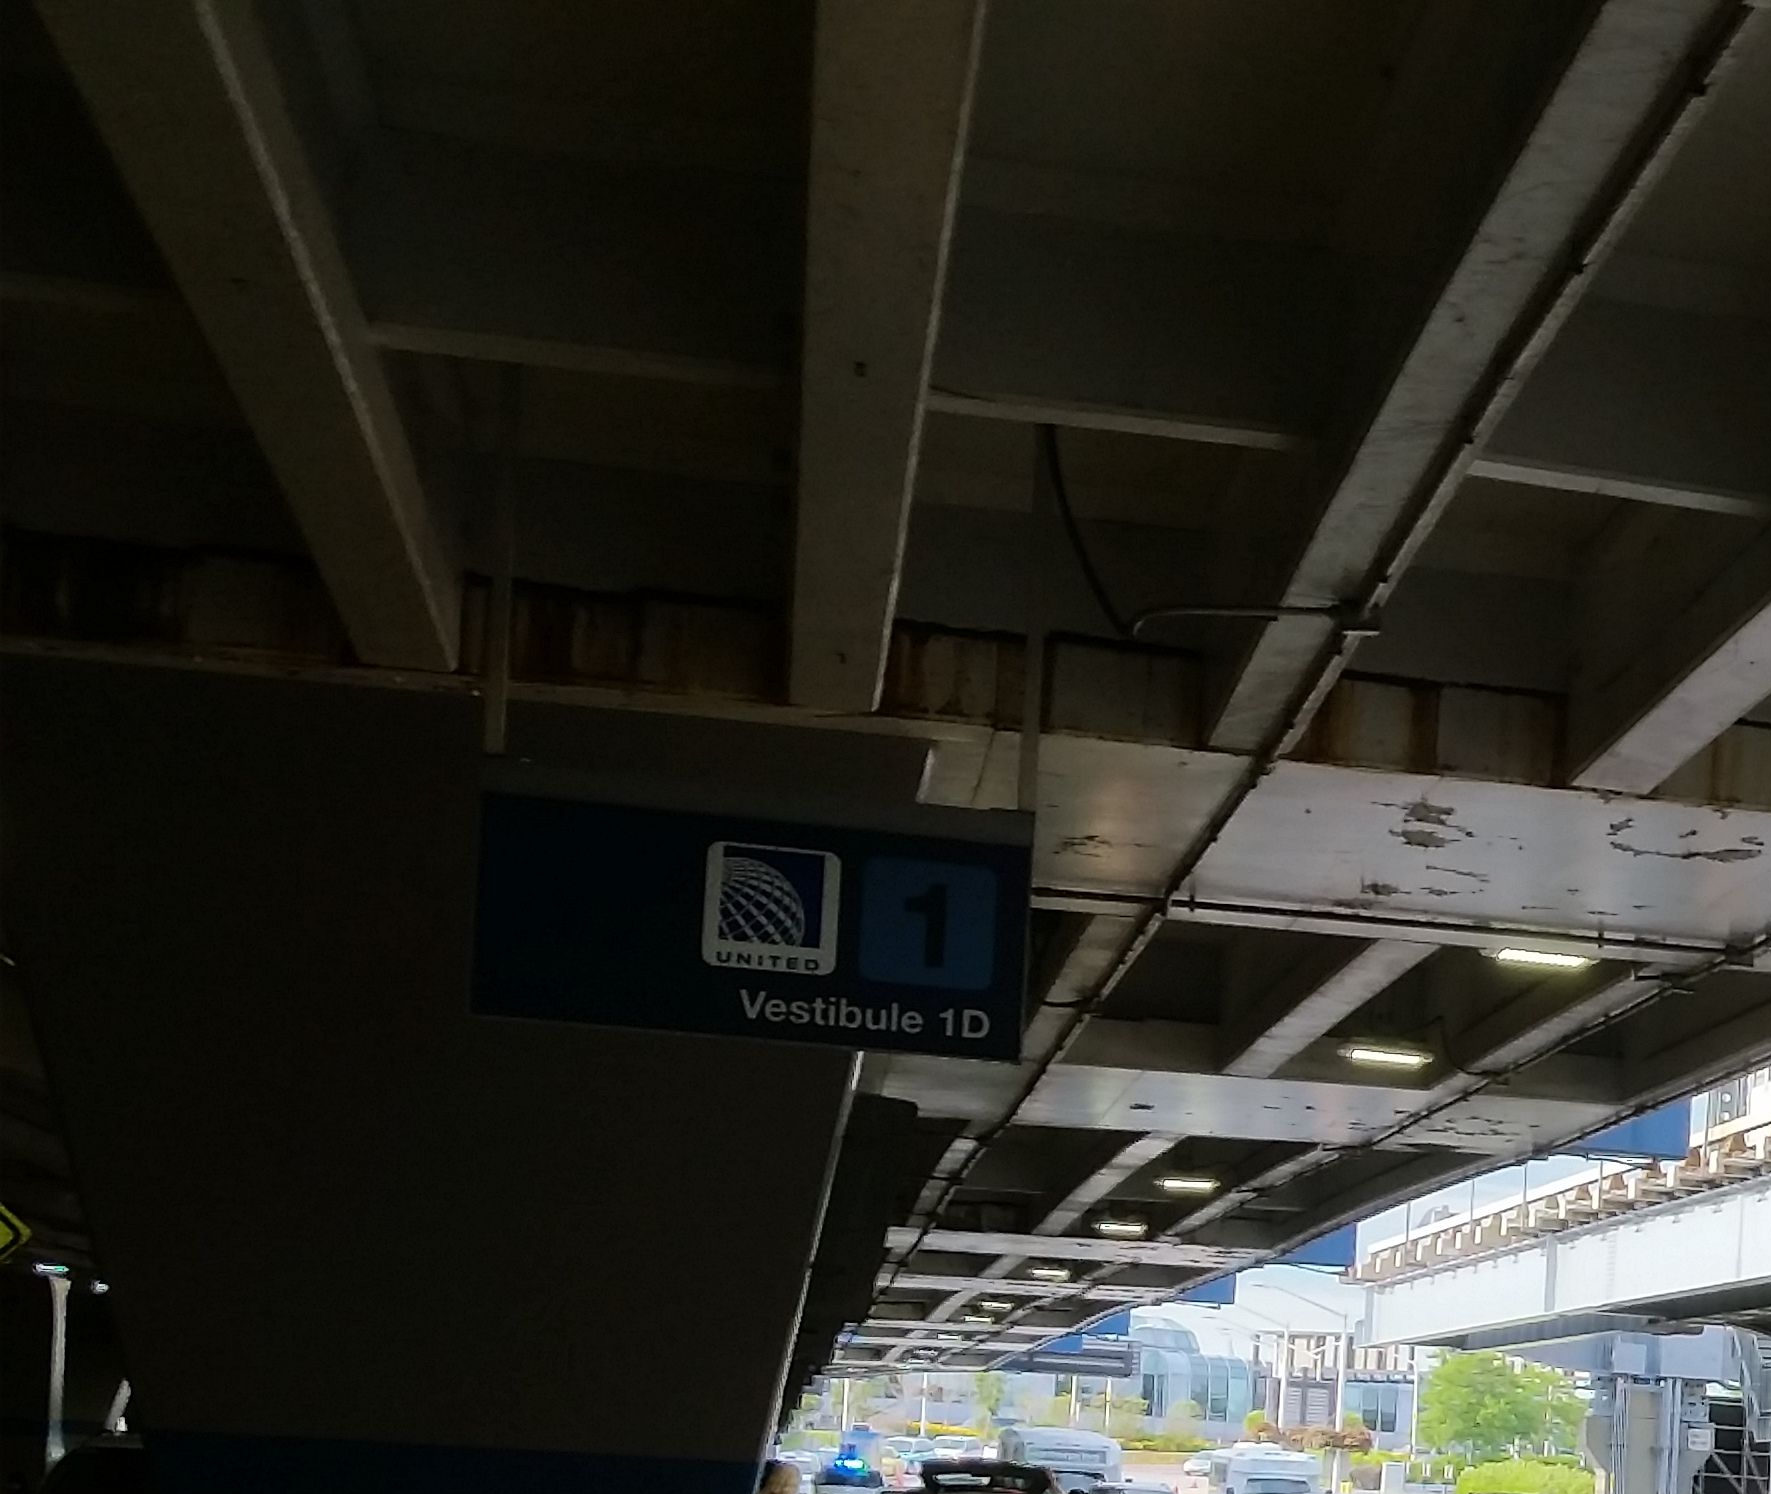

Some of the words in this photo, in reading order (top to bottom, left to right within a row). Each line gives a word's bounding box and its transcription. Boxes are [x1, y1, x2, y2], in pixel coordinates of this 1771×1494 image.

[905, 883, 946, 967] 1
[716, 951, 819, 971] UNITED
[739, 988, 925, 1034] Vestibule
[939, 1008, 991, 1039] 1D
